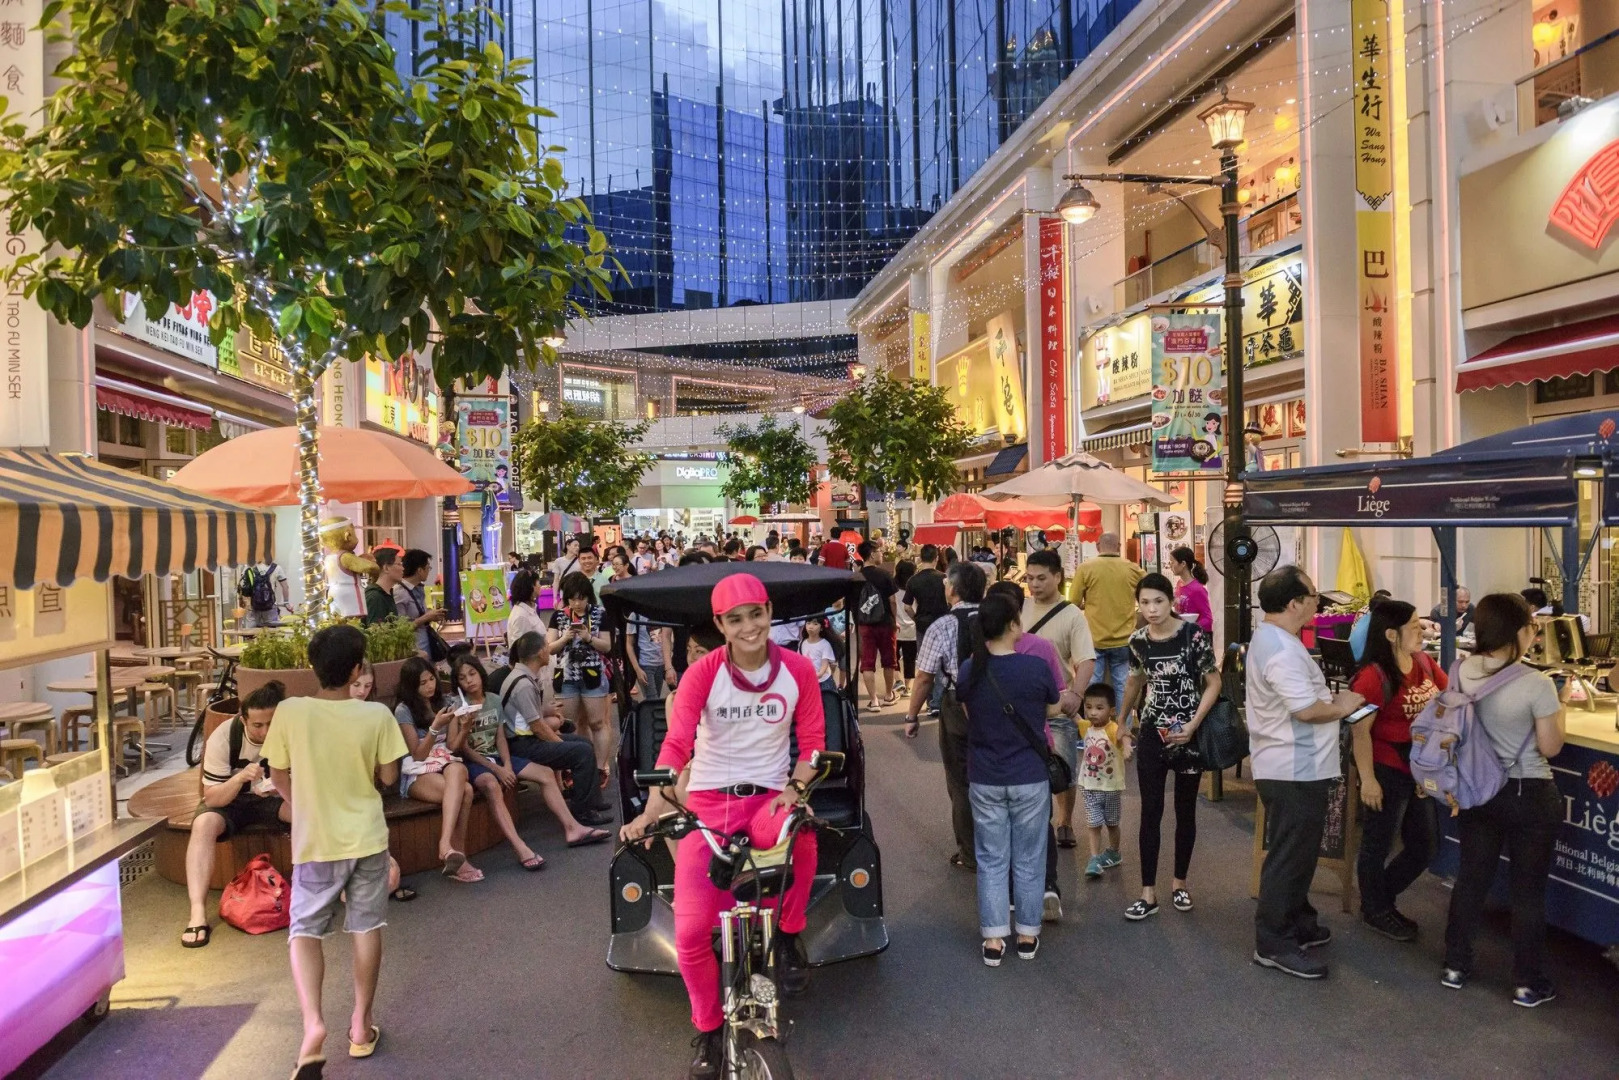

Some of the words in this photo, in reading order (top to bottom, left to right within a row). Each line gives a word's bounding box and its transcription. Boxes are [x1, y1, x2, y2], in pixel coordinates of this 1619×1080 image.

[0, 0, 25, 95] 麵食
[1360, 34, 1383, 120] 華生行
[1364, 126, 1381, 137] Wa
[1361, 140, 1386, 153] Sang
[1361, 153, 1387, 166] Hong
[7, 301, 19, 328] TAO
[8, 332, 20, 345] FU
[8, 350, 20, 374] MIN
[1161, 356, 1213, 386] $10
[9, 375, 21, 399] SEK
[1380, 377, 1388, 409] SHAN
[465, 427, 502, 448] $10
[1357, 495, 1390, 518] Liège
[716, 704, 777, 719] 澳門百老匯
